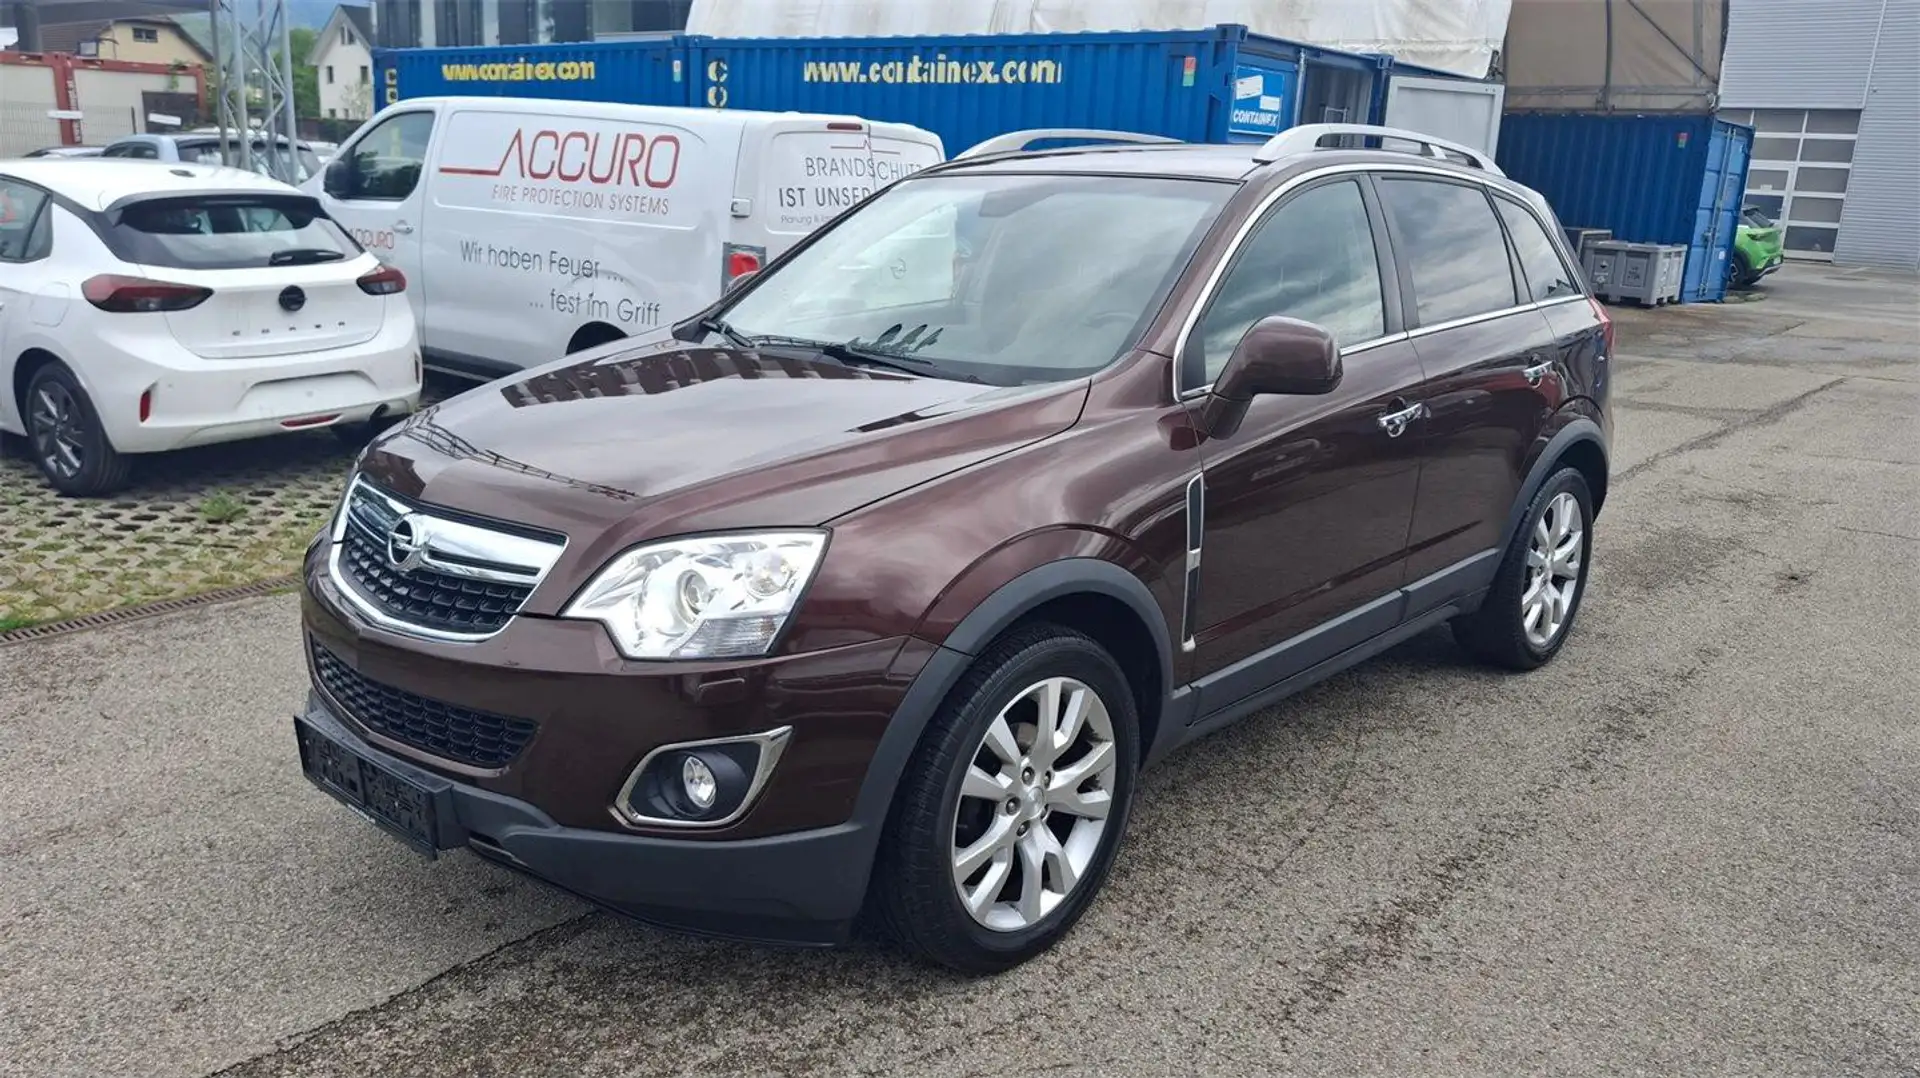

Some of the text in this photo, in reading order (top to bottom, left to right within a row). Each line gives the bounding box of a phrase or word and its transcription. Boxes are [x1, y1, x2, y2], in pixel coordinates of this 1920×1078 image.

[499, 127, 681, 189] ACCURO
[492, 184, 669, 215] FIRE PROTECTION SYSTEMS
[779, 187, 805, 207] IST
[460, 240, 484, 263] Wir
[487, 245, 543, 272] haben
[549, 250, 600, 279] Feuer
[550, 288, 582, 314] fest
[586, 292, 609, 319] im
[617, 298, 661, 326] Griff
